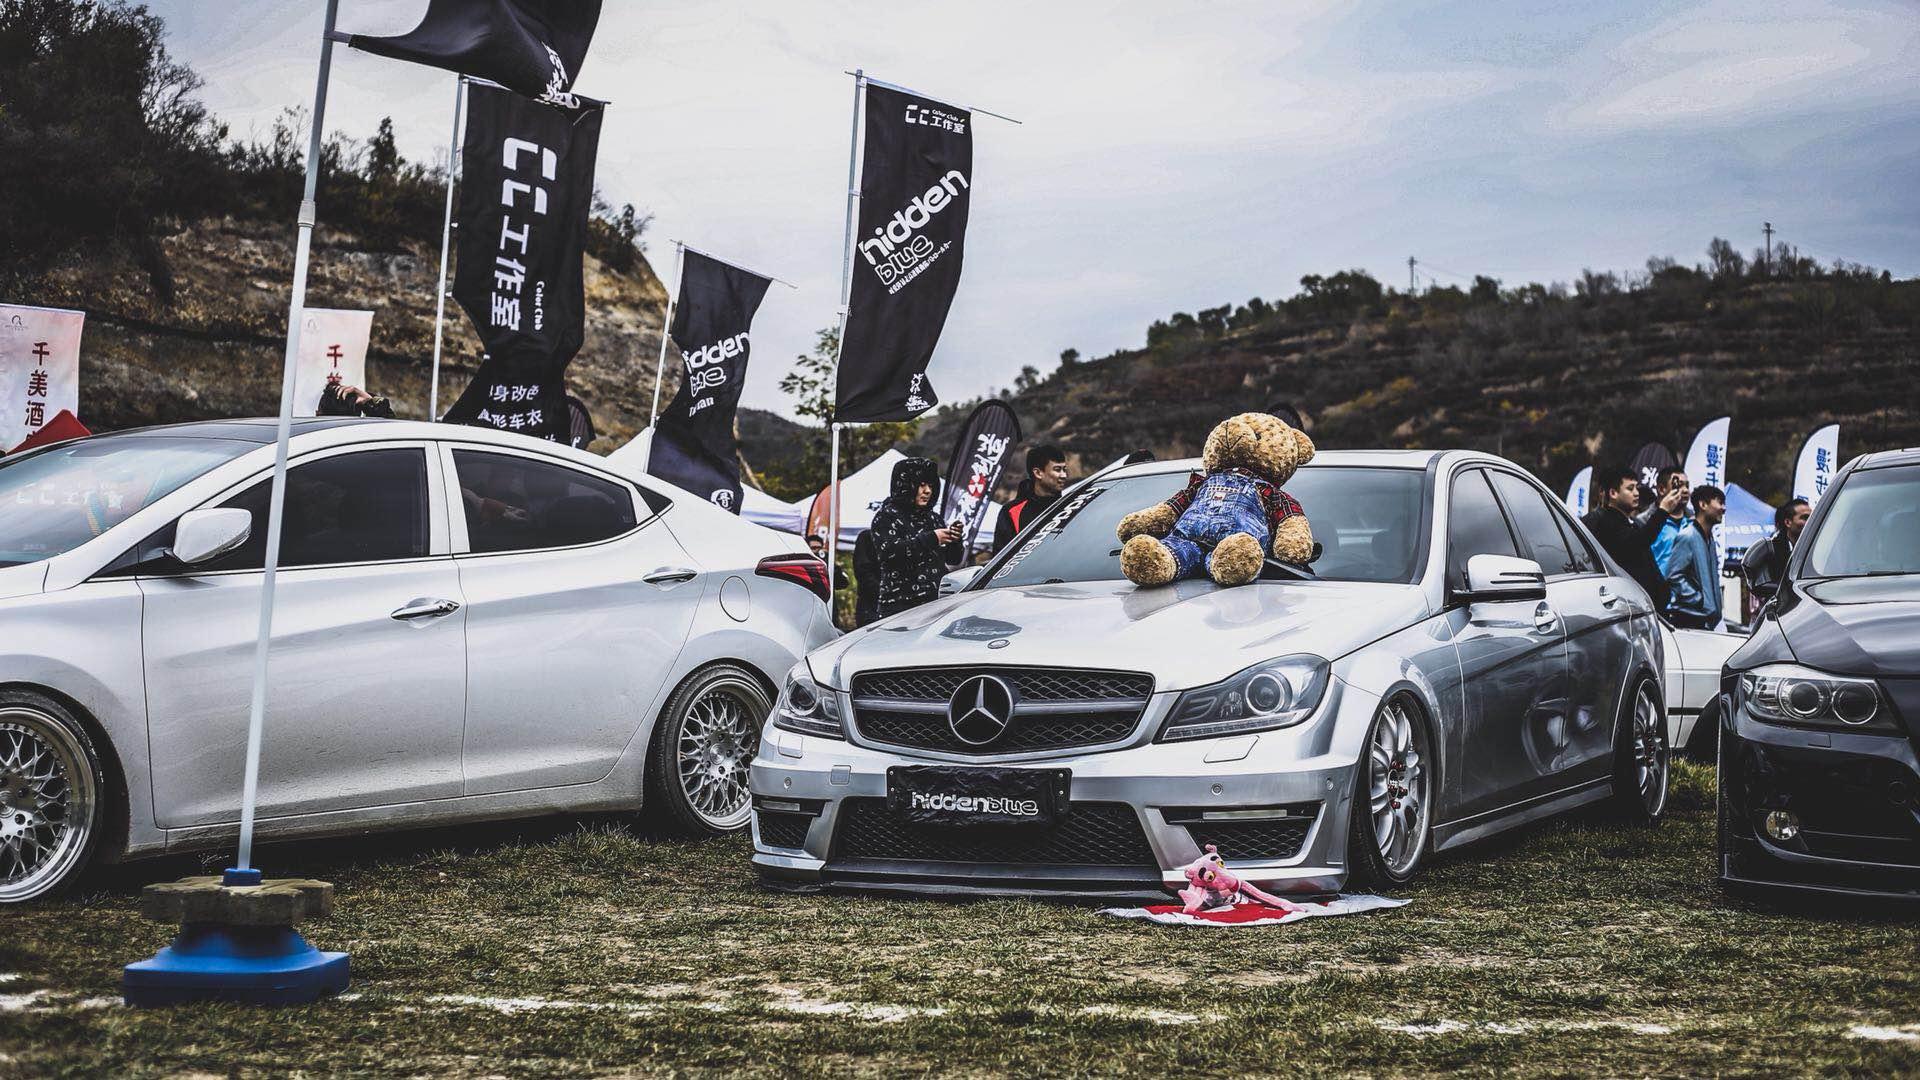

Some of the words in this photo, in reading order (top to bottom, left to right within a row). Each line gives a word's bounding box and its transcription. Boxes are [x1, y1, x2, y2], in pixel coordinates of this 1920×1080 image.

[858, 169, 969, 266] hidden
[874, 234, 934, 286] blue
[24, 341, 50, 441] 千美酒
[488, 384, 540, 402] 身改色
